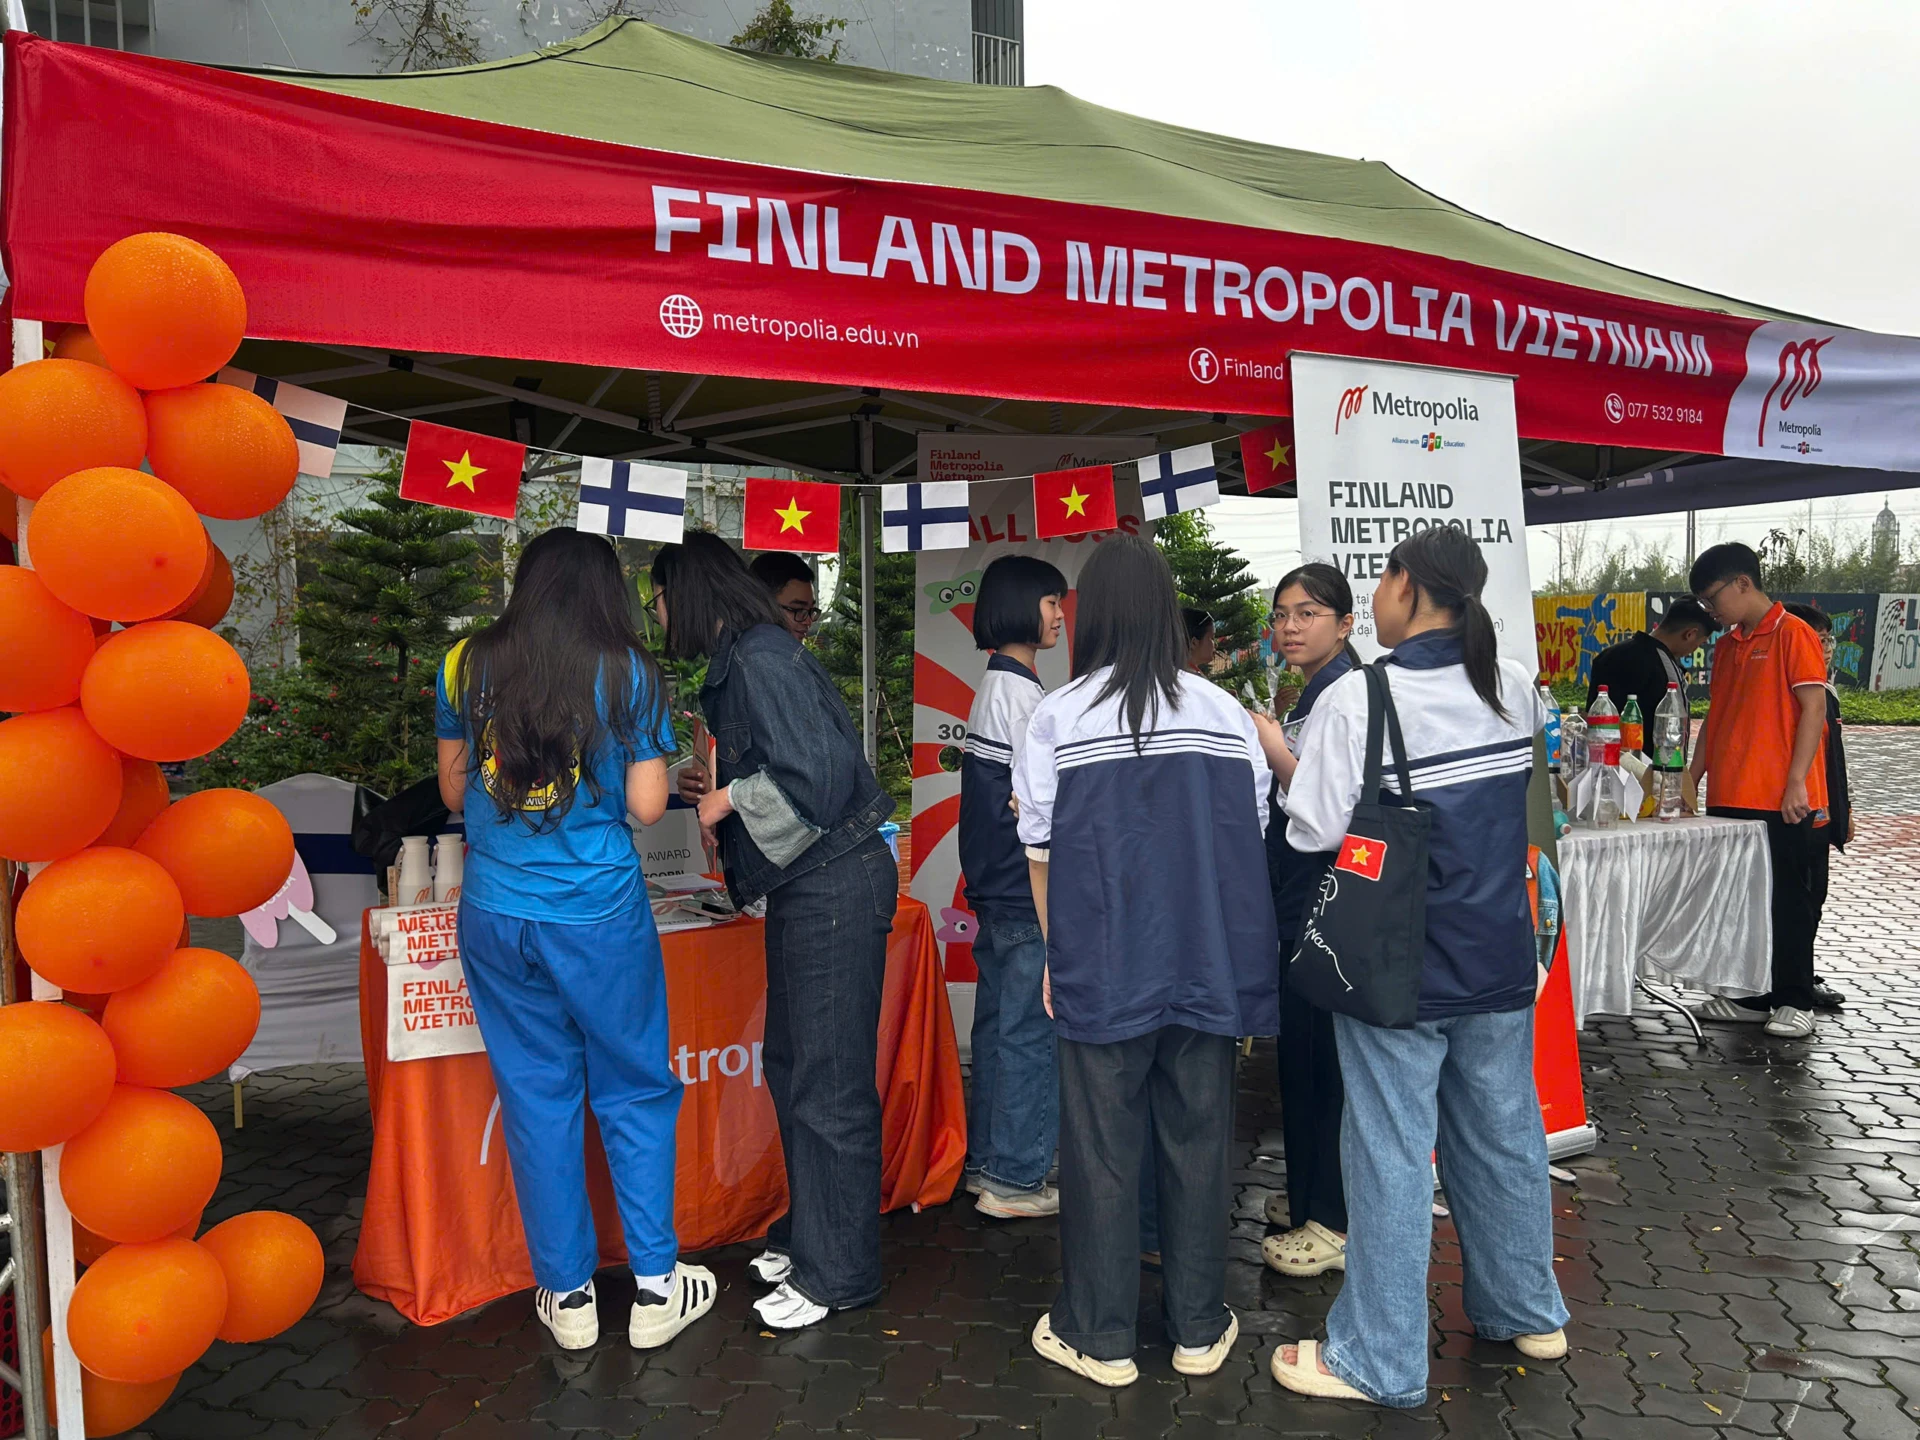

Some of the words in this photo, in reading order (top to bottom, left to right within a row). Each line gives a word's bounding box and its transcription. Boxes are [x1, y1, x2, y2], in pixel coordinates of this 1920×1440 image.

[651, 185, 1040, 294] FINLAND
[1066, 240, 1475, 346] METROPOLIA
[1493, 300, 1713, 377] VIETNAM
[713, 312, 919, 348] metropolia.edu.vn
[1224, 358, 1284, 381] Finland
[1372, 391, 1479, 426] Metropolia
[1627, 402, 1648, 418] 077
[1652, 406, 1673, 421] 532
[1676, 407, 1703, 424] 9184
[1779, 420, 1821, 438] Metropolia
[930, 449, 981, 461] Finland
[930, 460, 1004, 473] Metropolia
[1328, 481, 1454, 509] FINLAND
[937, 723, 966, 740] 30
[525, 797, 545, 806] WILL
[647, 848, 691, 862] AWARD
